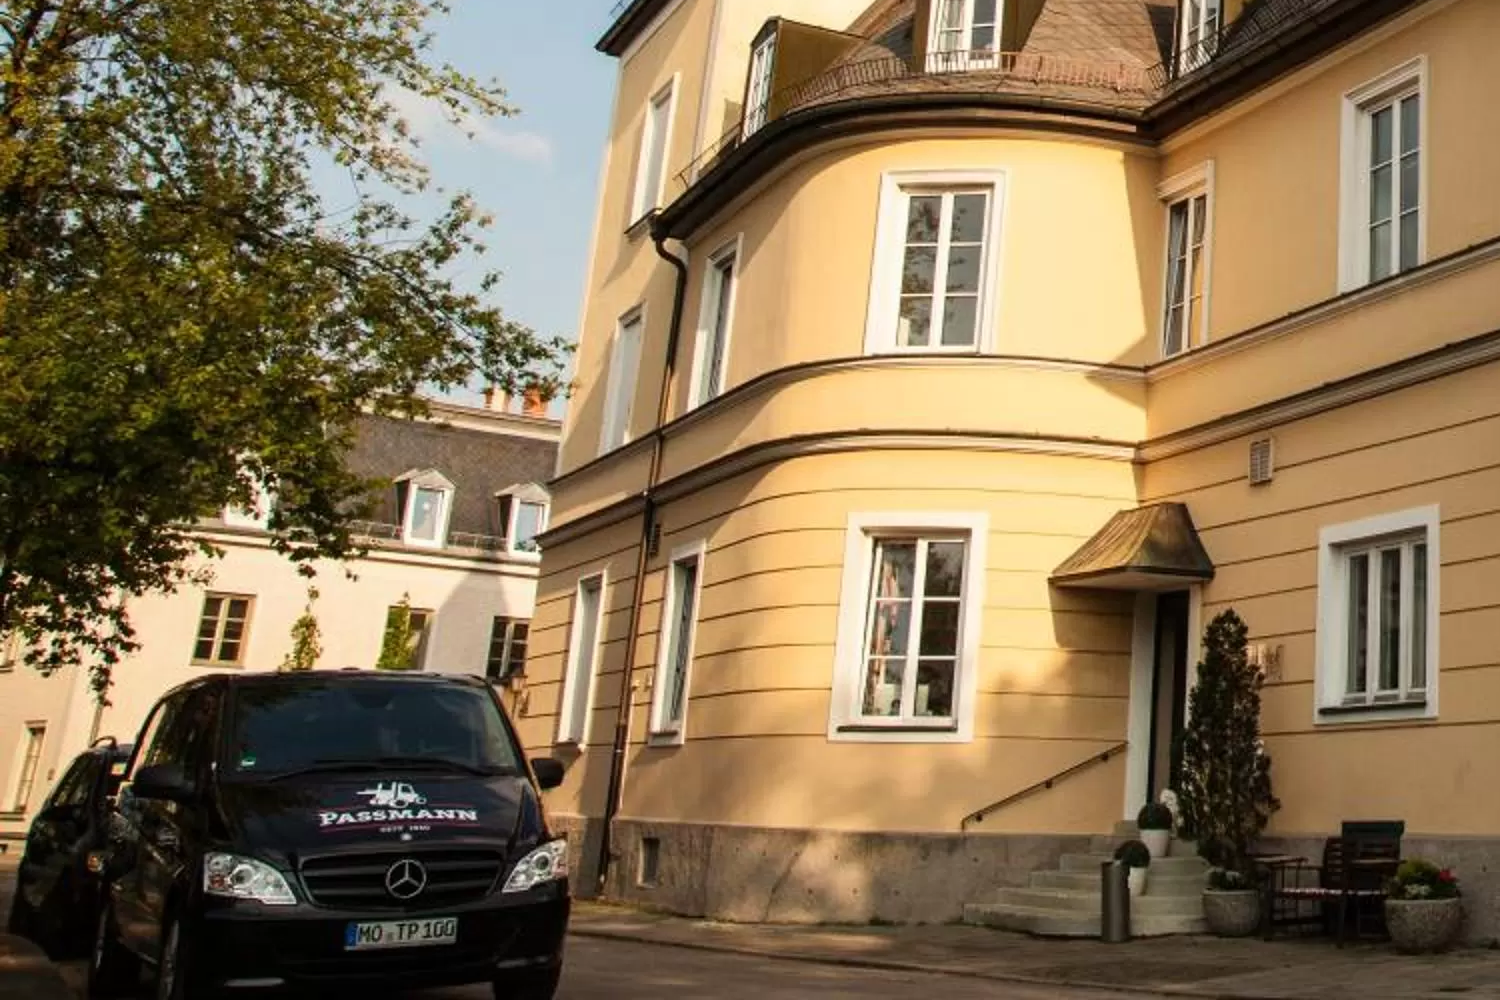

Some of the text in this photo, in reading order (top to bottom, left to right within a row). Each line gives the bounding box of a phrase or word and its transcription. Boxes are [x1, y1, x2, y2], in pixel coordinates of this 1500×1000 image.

[319, 809, 478, 827] PASSMANN
[358, 918, 455, 942] MO TP 100
